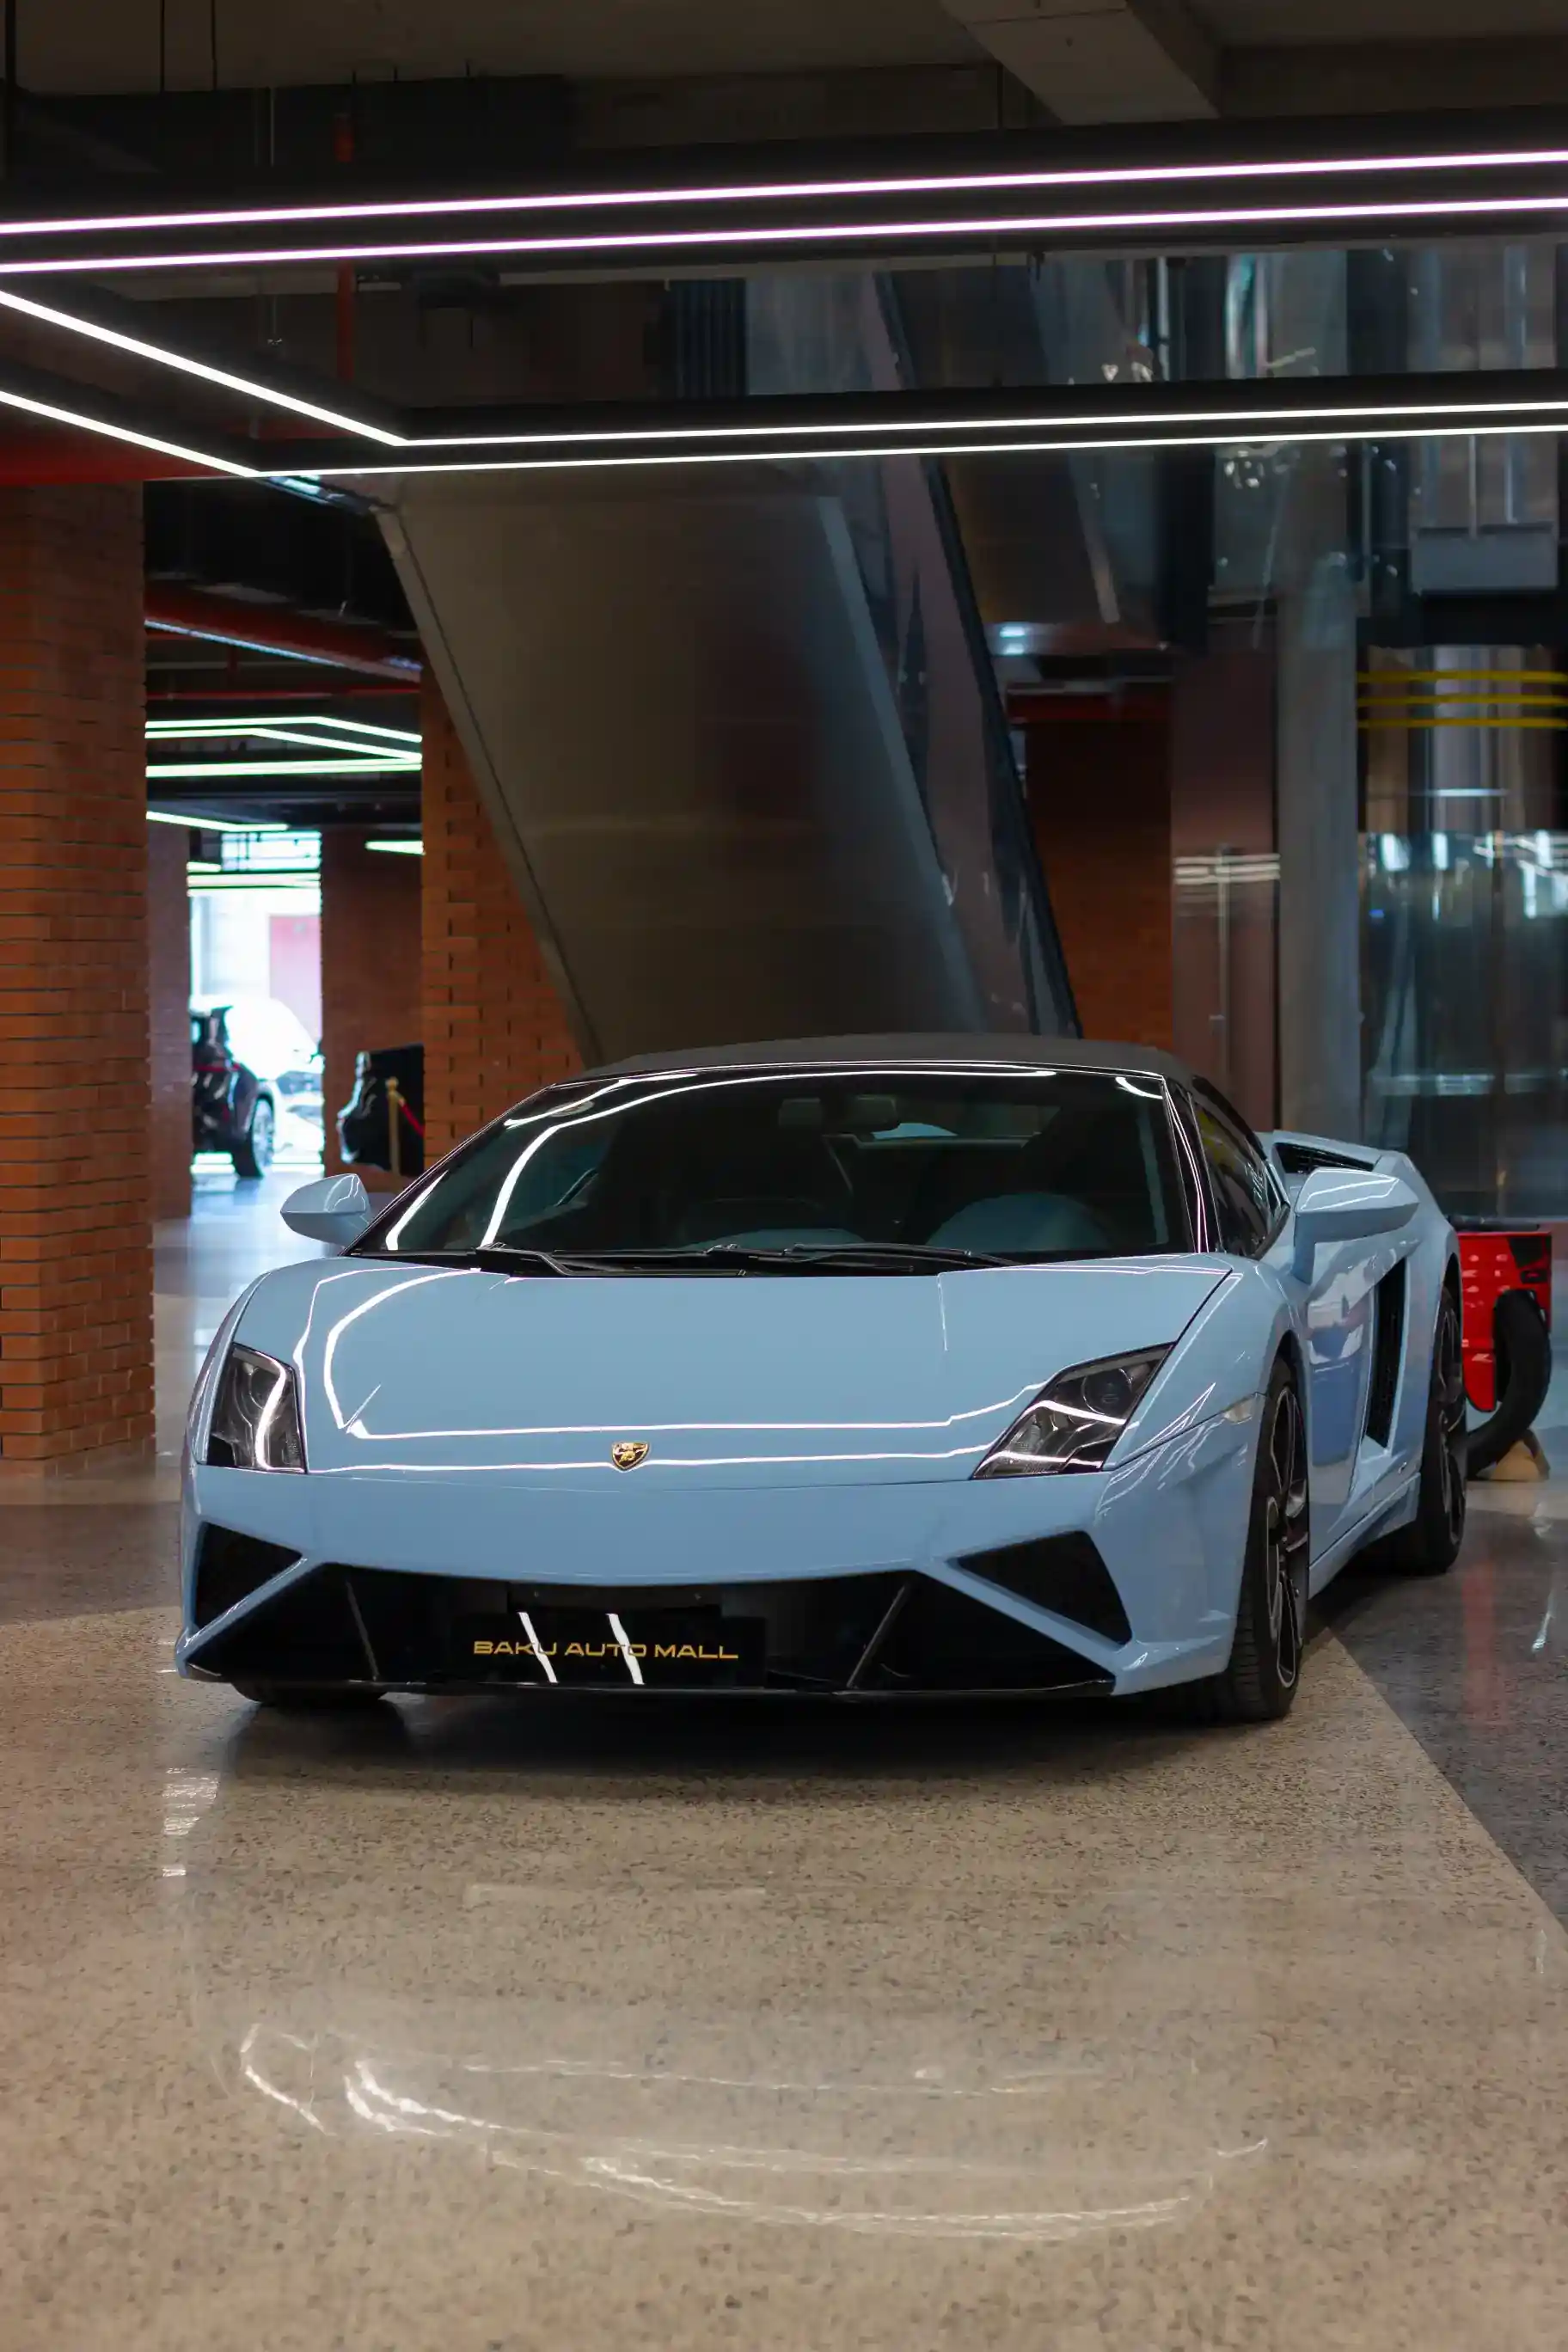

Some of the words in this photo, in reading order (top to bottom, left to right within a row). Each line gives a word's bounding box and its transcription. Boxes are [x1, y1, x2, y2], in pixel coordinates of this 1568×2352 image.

[474, 1641, 557, 1656] BAKU
[564, 1642, 646, 1657] AUTO
[654, 1644, 738, 1659] MALL
